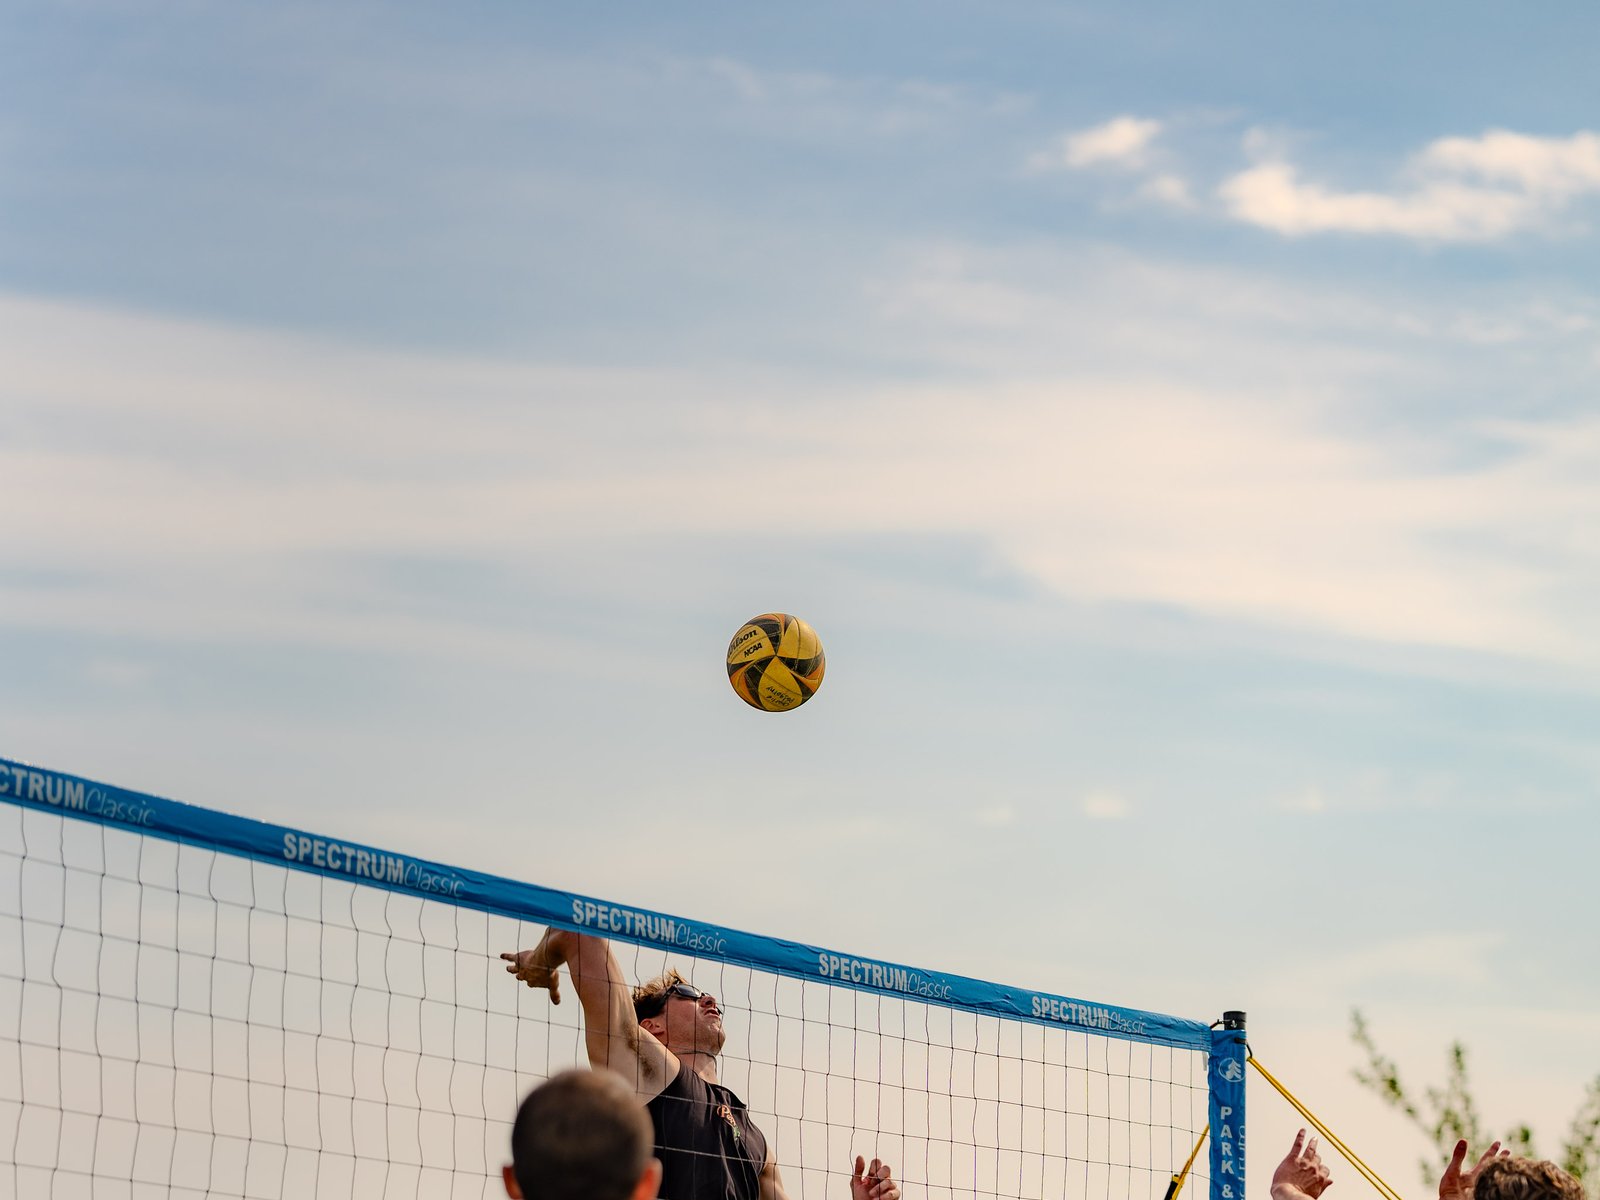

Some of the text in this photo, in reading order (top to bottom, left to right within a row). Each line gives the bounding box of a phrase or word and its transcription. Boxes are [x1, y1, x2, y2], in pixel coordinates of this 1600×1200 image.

[744, 642, 762, 657] NCAA
[84, 787, 156, 826] Classic
[283, 832, 465, 898] SPECTRUM Classic
[572, 899, 727, 954] SPECTRUM Classic
[818, 953, 953, 1000] SPECTRUM Classic
[1032, 995, 1148, 1035] SPECTRUM Classic
[1220, 1106, 1234, 1174] PARK
[1221, 1184, 1234, 1199] &
